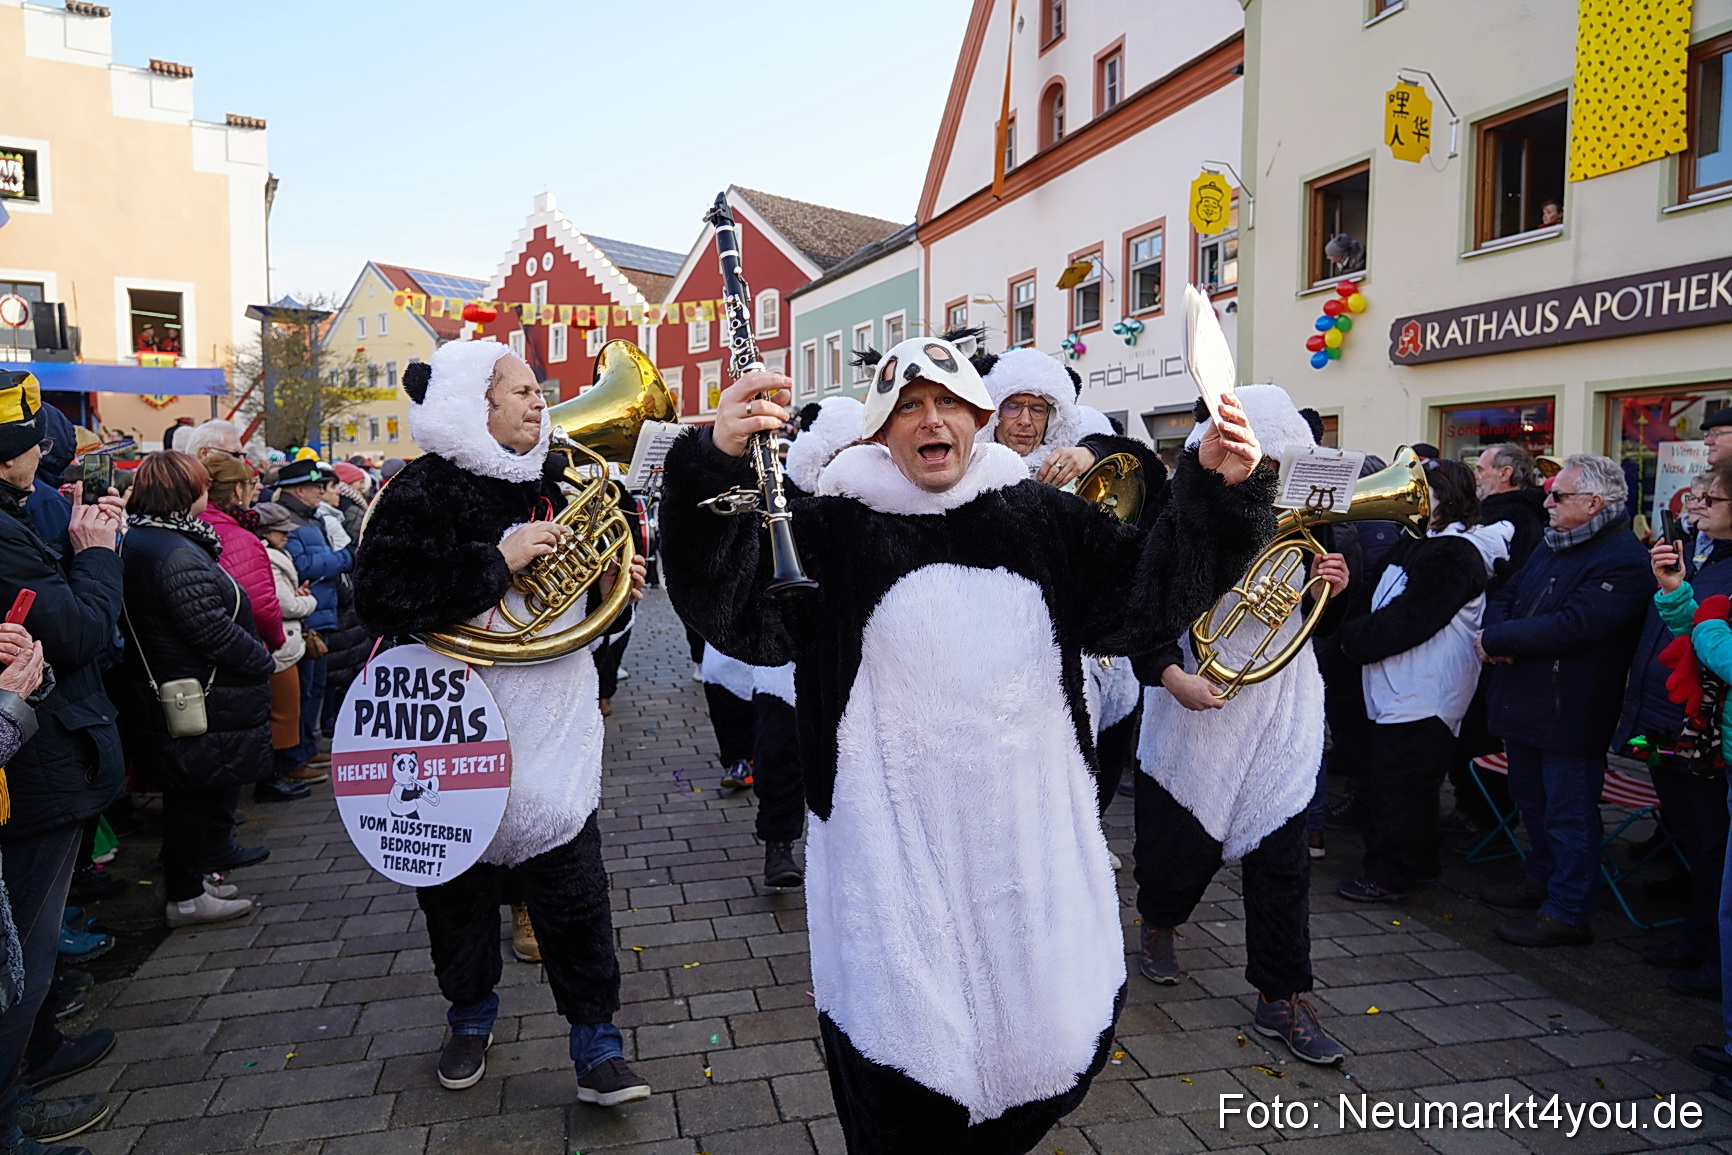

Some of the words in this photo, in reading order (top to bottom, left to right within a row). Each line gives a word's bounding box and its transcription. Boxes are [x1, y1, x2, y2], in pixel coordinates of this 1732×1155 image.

[1424, 300, 1560, 350] RATHAUS
[1564, 269, 1732, 330] APOTHEK
[1661, 462, 1687, 474] Nase
[374, 666, 466, 703] BRASS
[354, 700, 488, 743] PANDAS
[337, 762, 388, 782] HELFEN
[423, 758, 447, 777] SIE
[359, 815, 388, 833] VOM
[391, 819, 473, 843] AUSSTERBEN
[380, 836, 447, 859] BEDROHTE
